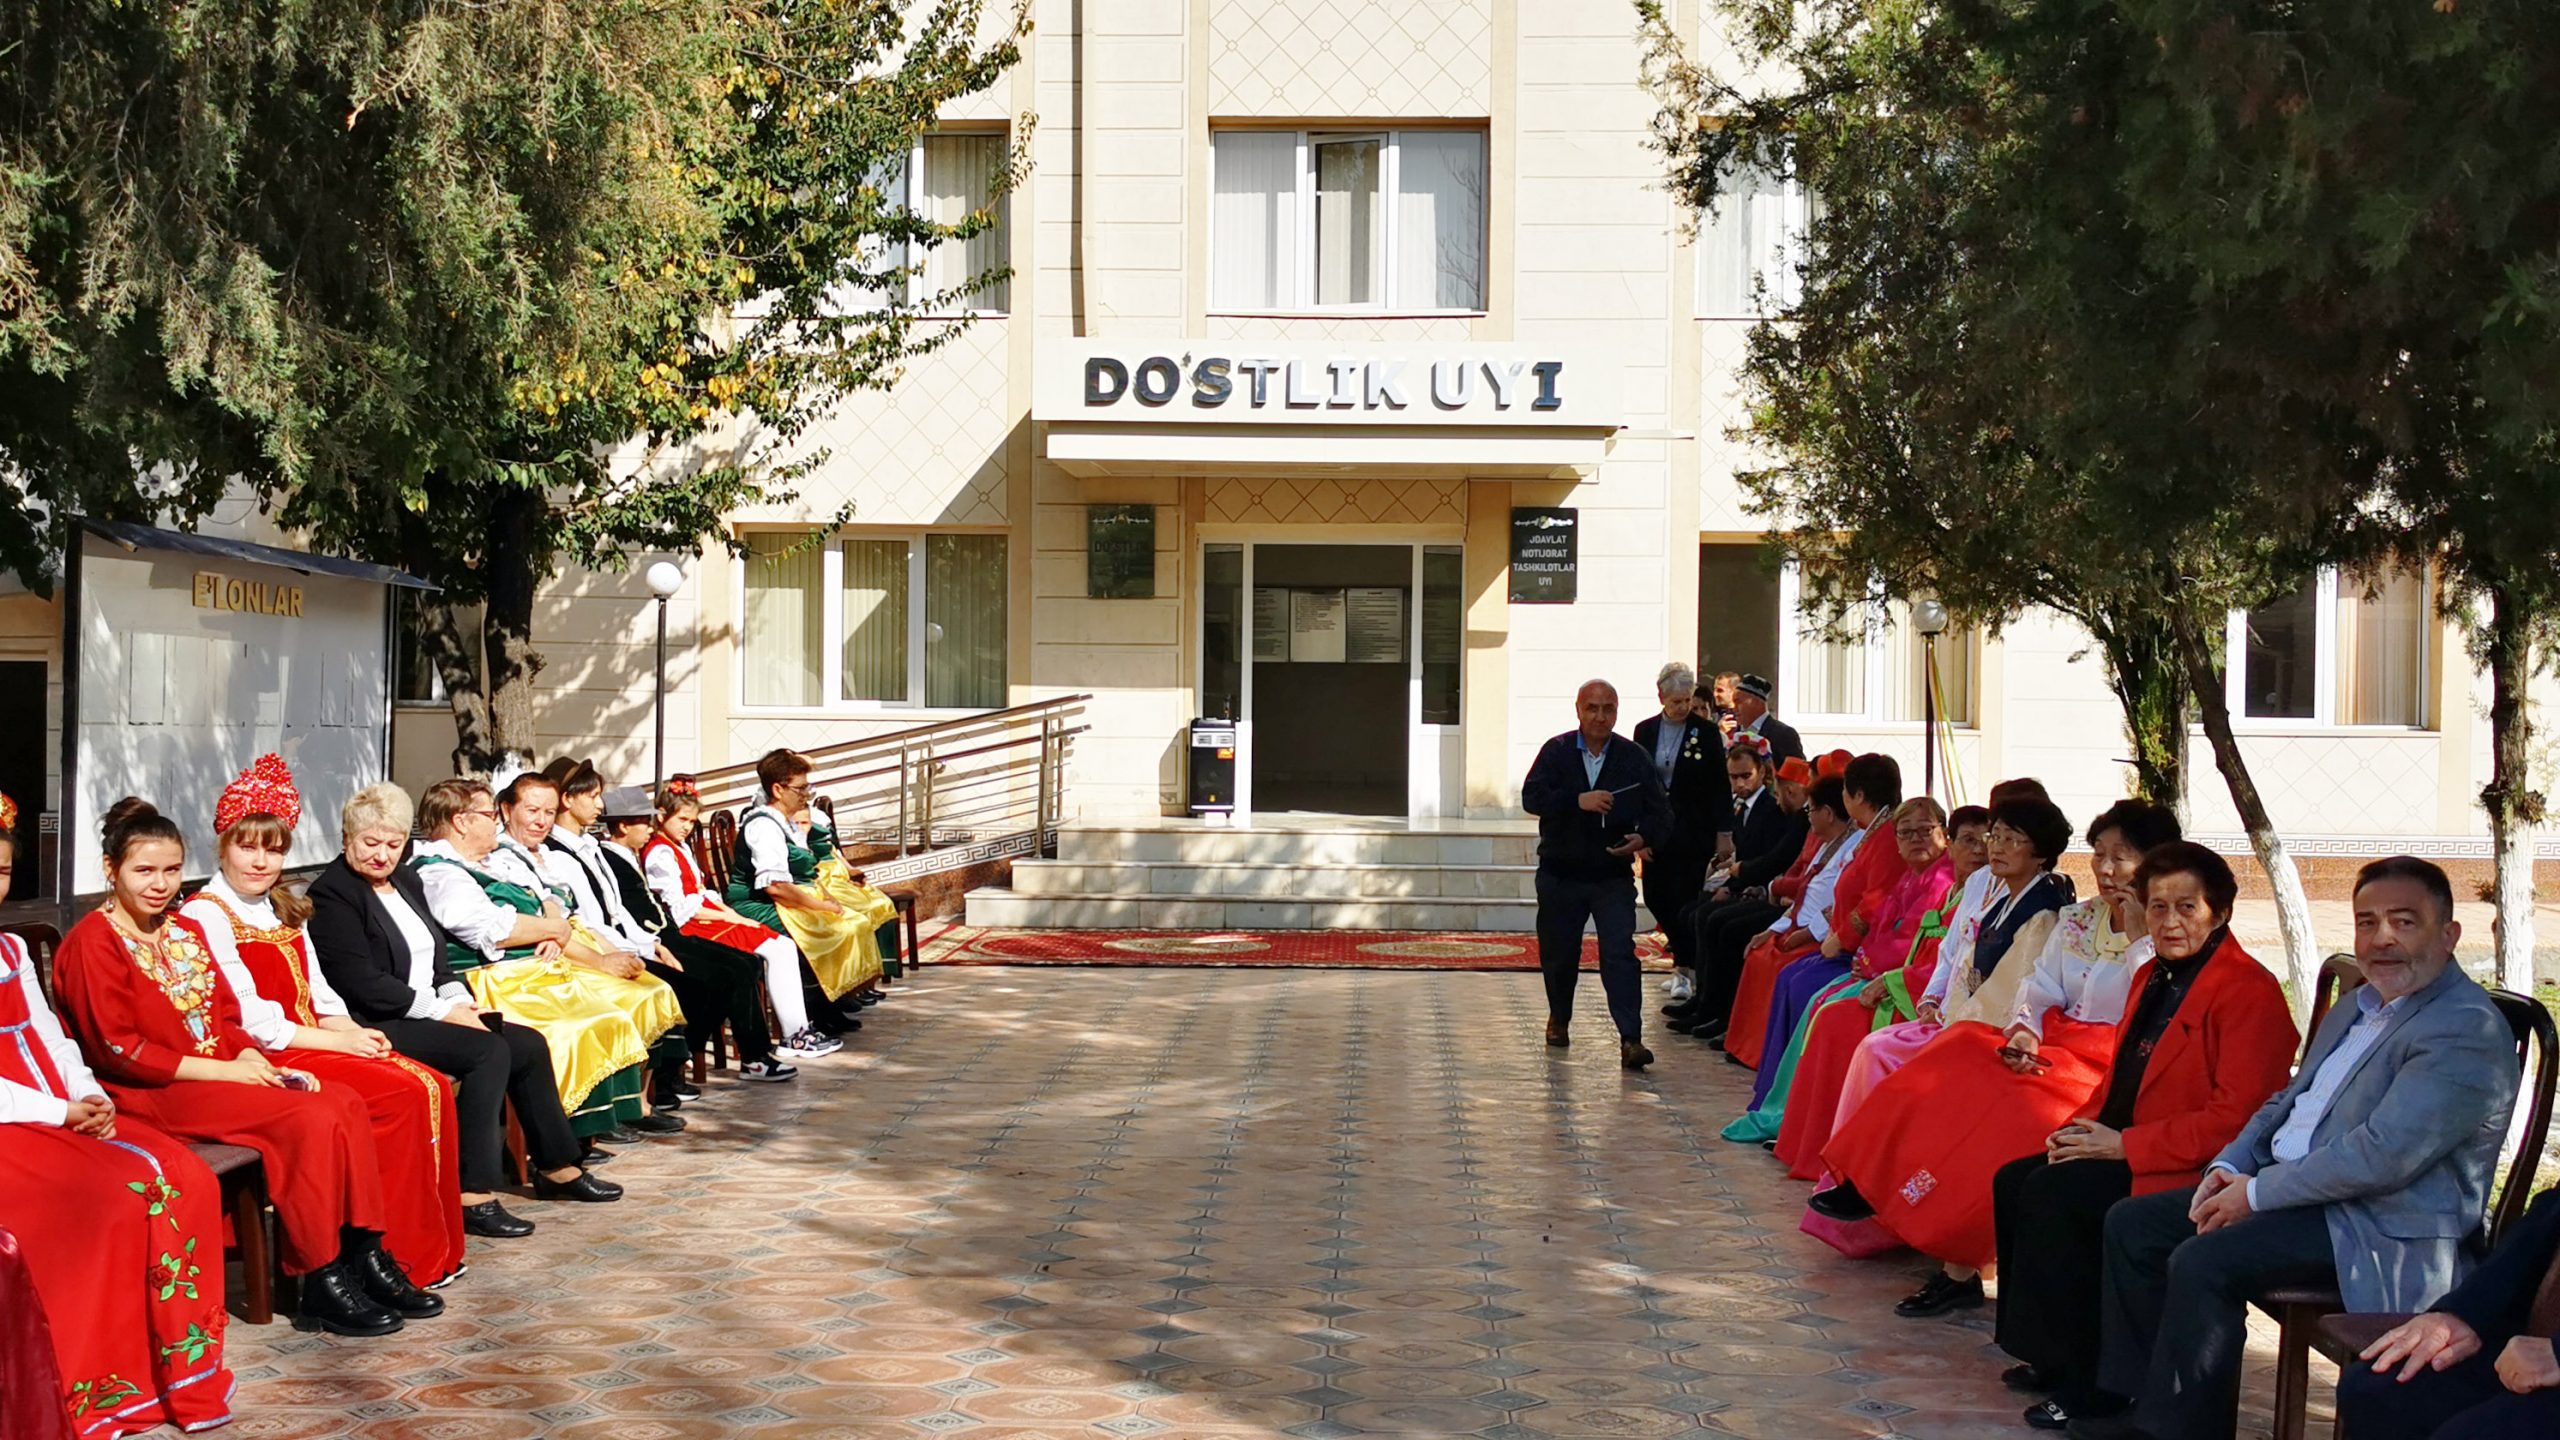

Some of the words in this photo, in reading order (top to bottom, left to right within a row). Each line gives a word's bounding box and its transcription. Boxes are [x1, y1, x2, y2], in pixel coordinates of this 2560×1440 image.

[1431, 361, 1562, 411] UYI
[1521, 548, 1568, 558] NOTIJORAT
[1513, 562, 1575, 572] TASHKILOTLAR
[1538, 577, 1552, 586] UYI
